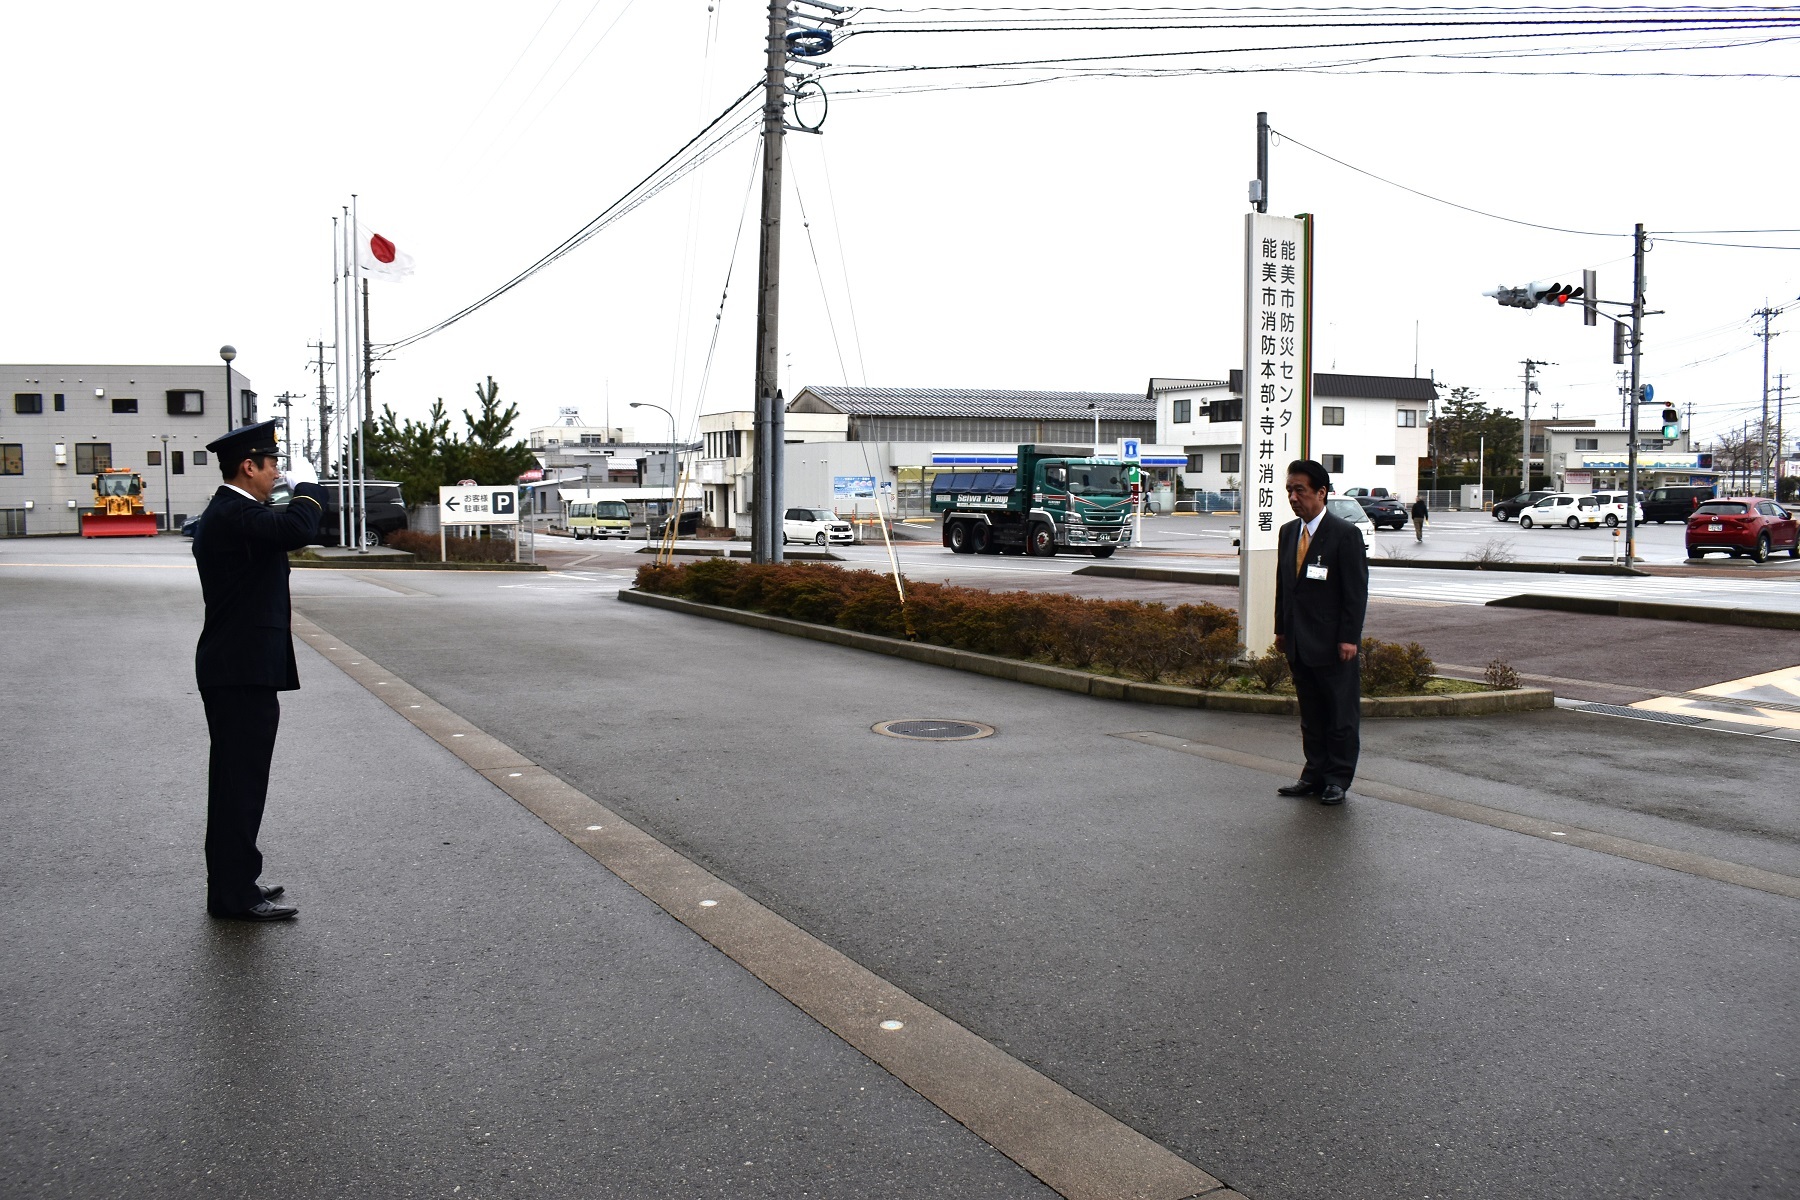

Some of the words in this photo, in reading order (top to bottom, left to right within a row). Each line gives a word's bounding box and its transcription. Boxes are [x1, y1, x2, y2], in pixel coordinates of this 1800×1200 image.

[1280, 240, 1296, 451] 能美市防災センター
[1258, 237, 1277, 532] 能美市消防本部・寺井消防署
[464, 494, 488, 503] お客様
[497, 495, 510, 512] P
[984, 495, 1009, 504] Group
[464, 504, 488, 513] 駐車場
